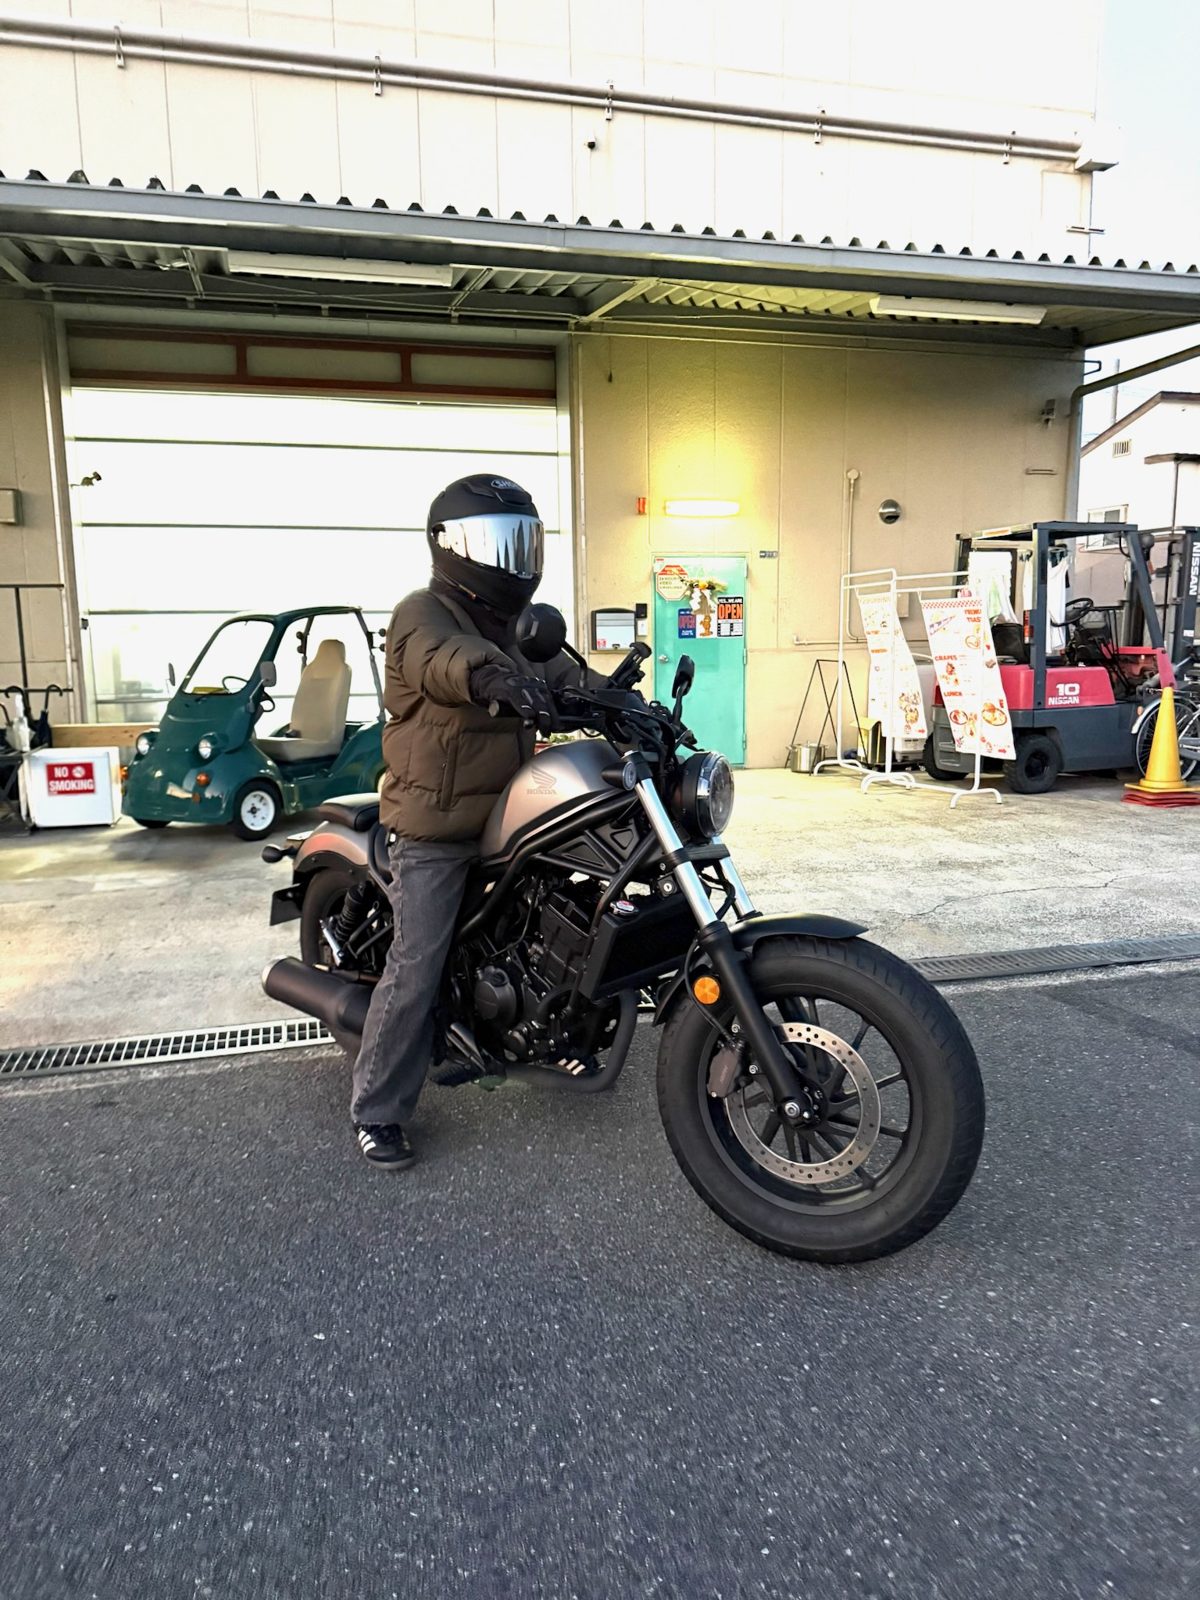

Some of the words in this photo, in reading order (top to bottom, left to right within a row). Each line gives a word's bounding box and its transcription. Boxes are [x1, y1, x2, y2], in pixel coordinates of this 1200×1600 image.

[1189, 541, 1200, 596] NISSAN
[718, 603, 742, 619] OPEN
[1055, 683, 1080, 696] 10
[1048, 696, 1080, 705] NISSAN
[54, 766, 69, 778] NO
[49, 779, 94, 791] SMOKING
